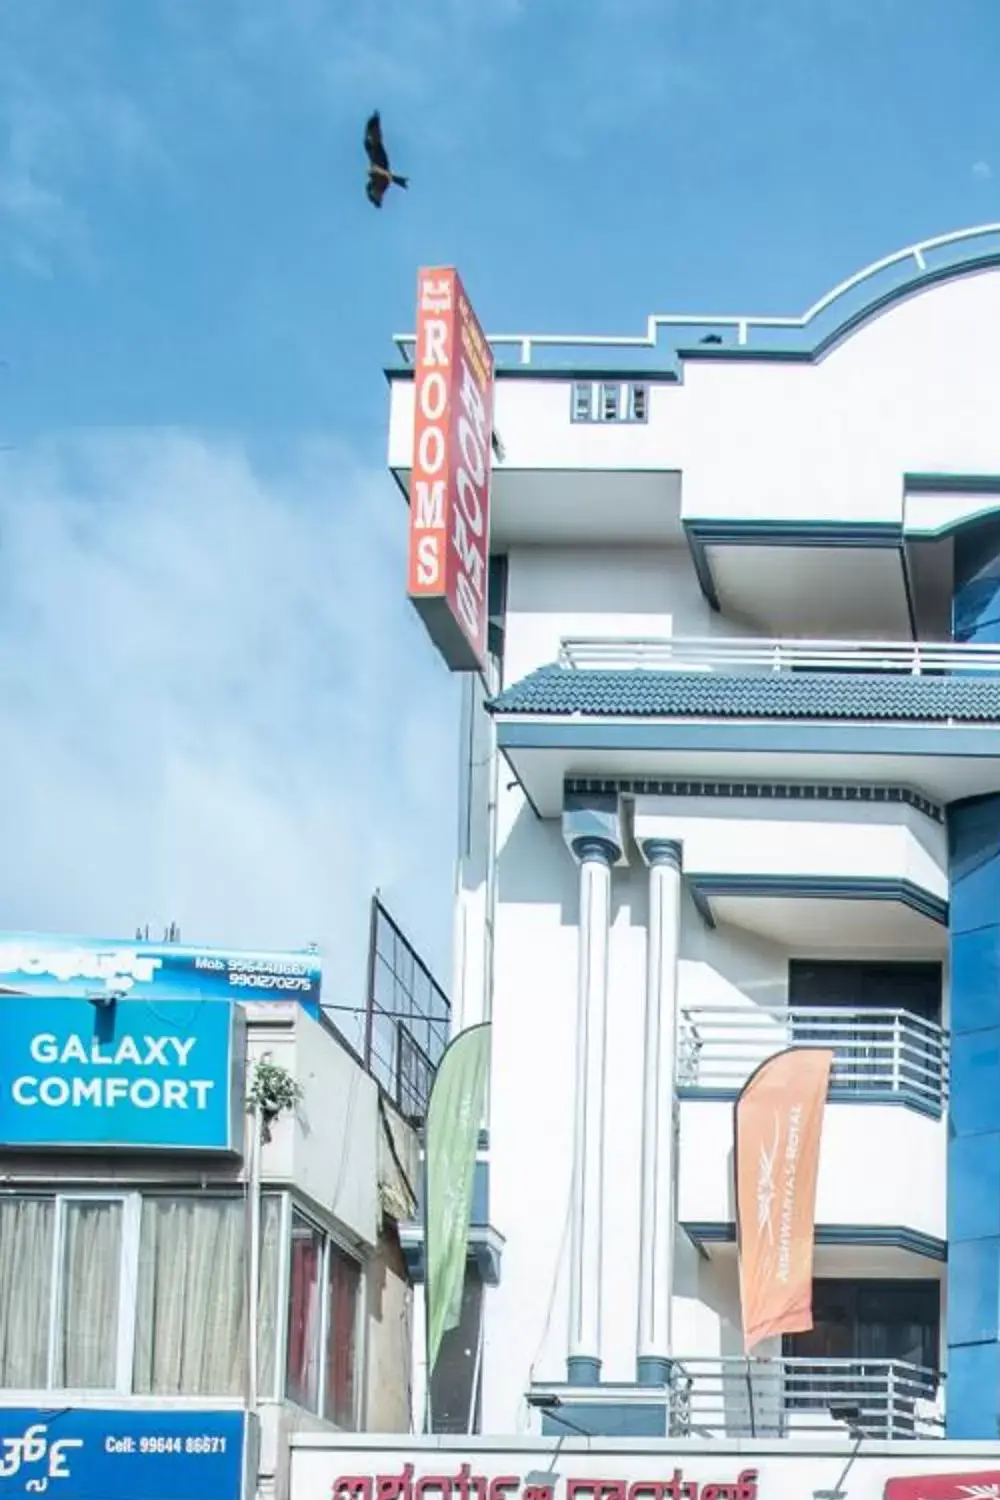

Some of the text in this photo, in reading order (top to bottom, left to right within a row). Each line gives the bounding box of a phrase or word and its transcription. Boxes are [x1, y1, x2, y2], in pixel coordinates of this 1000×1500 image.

[415, 320, 449, 586] ROOMS
[452, 357, 489, 640] ROOMS
[30, 1034, 196, 1066] GALAXY
[12, 1076, 214, 1110] COMFORT
[105, 1436, 136, 1453] Cell:
[140, 1435, 181, 1453] 99644
